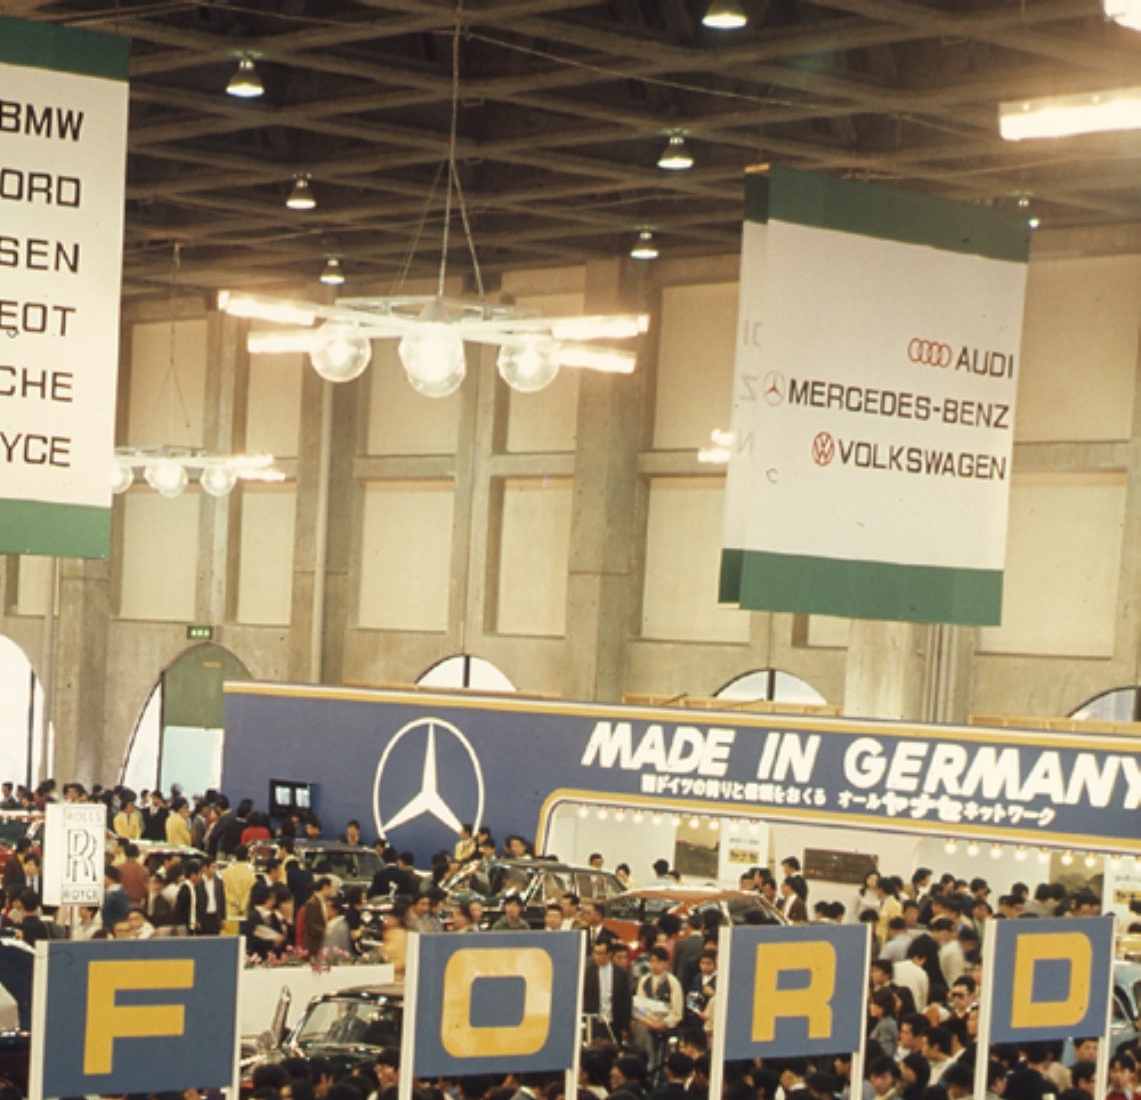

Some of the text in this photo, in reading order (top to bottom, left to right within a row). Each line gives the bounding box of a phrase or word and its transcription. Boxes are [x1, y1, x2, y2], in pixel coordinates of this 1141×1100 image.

[954, 346, 1014, 380] AUDI
[788, 378, 1009, 429] MERCEDES-BENZ
[837, 438, 1006, 481] VOLKSWAGEN
[580, 720, 1141, 811] MADE IN GERMANY
